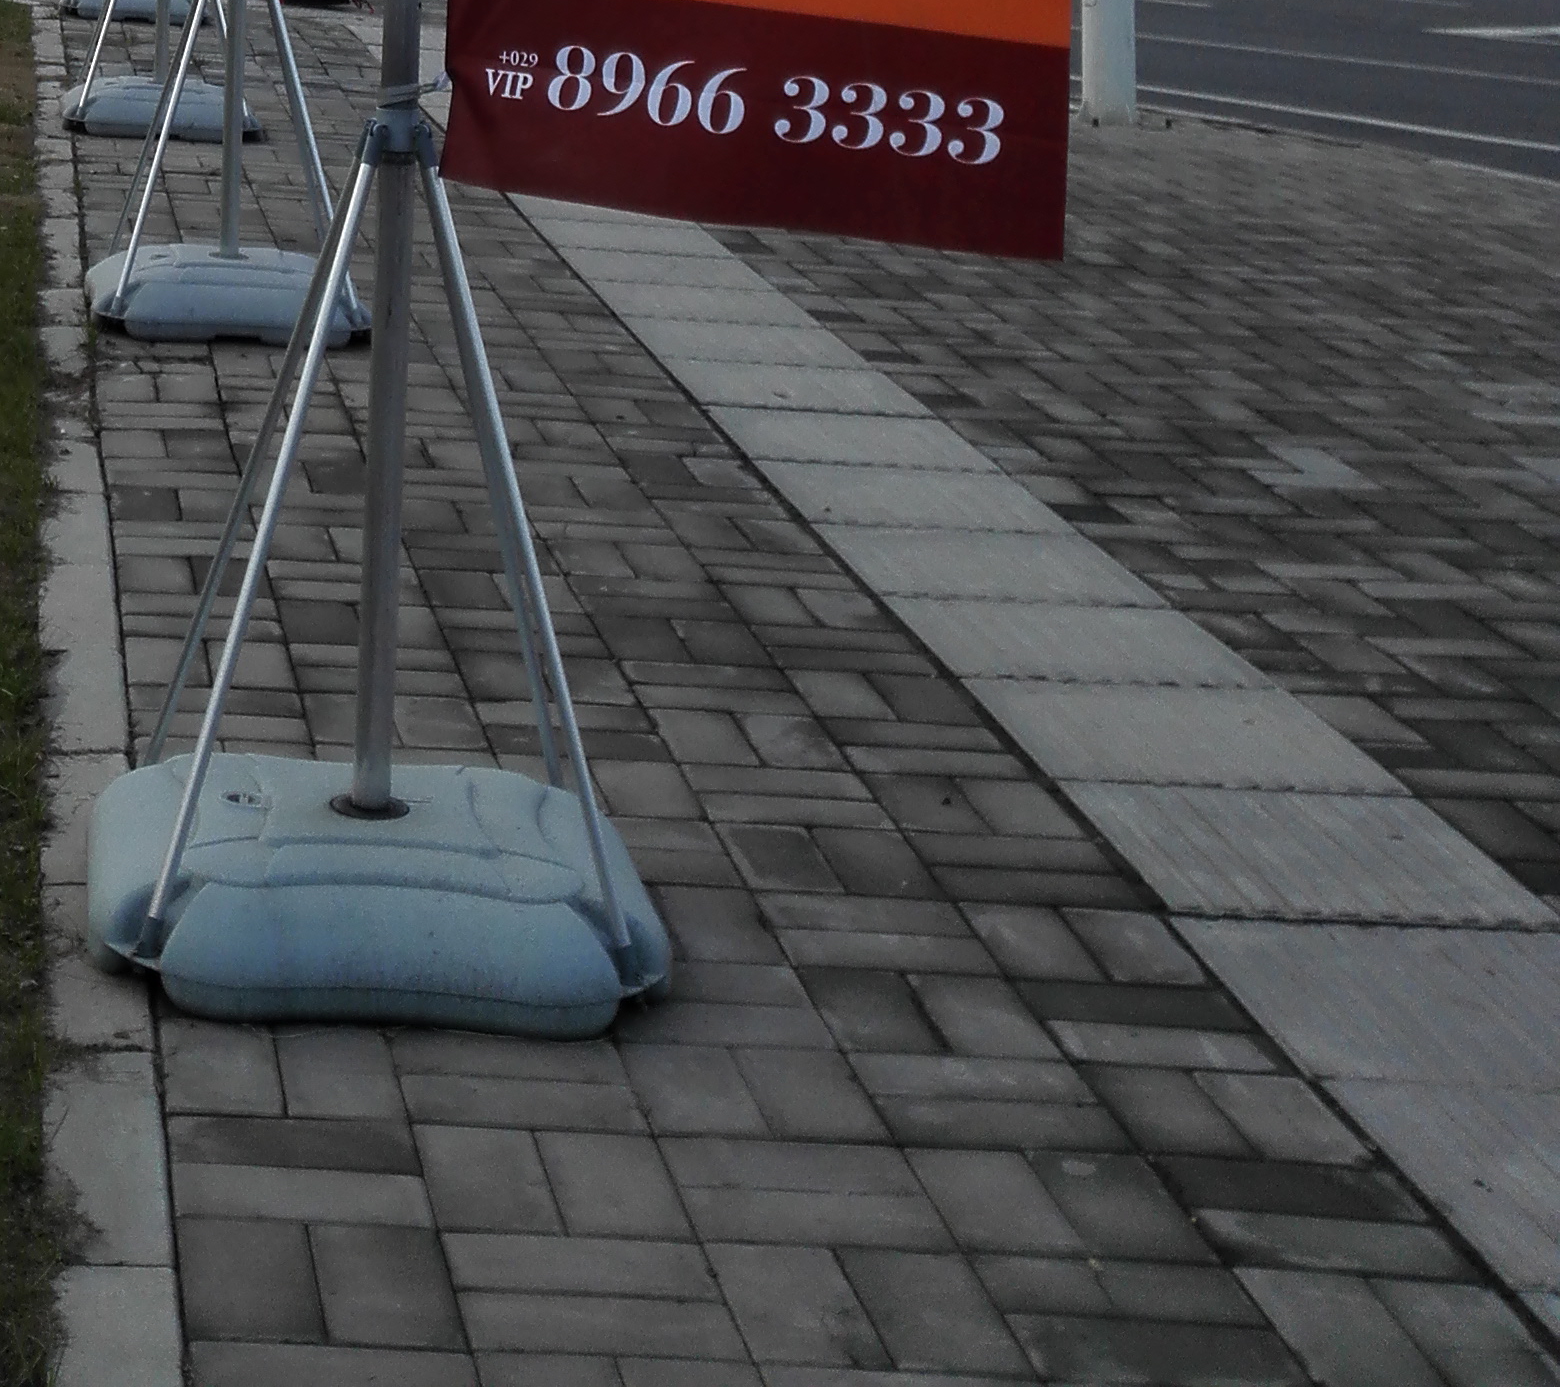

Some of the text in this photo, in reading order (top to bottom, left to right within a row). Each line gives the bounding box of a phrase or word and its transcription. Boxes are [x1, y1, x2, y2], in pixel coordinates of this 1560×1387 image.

[499, 50, 539, 68] +029
[485, 45, 1005, 165] VIP 8966 3333
